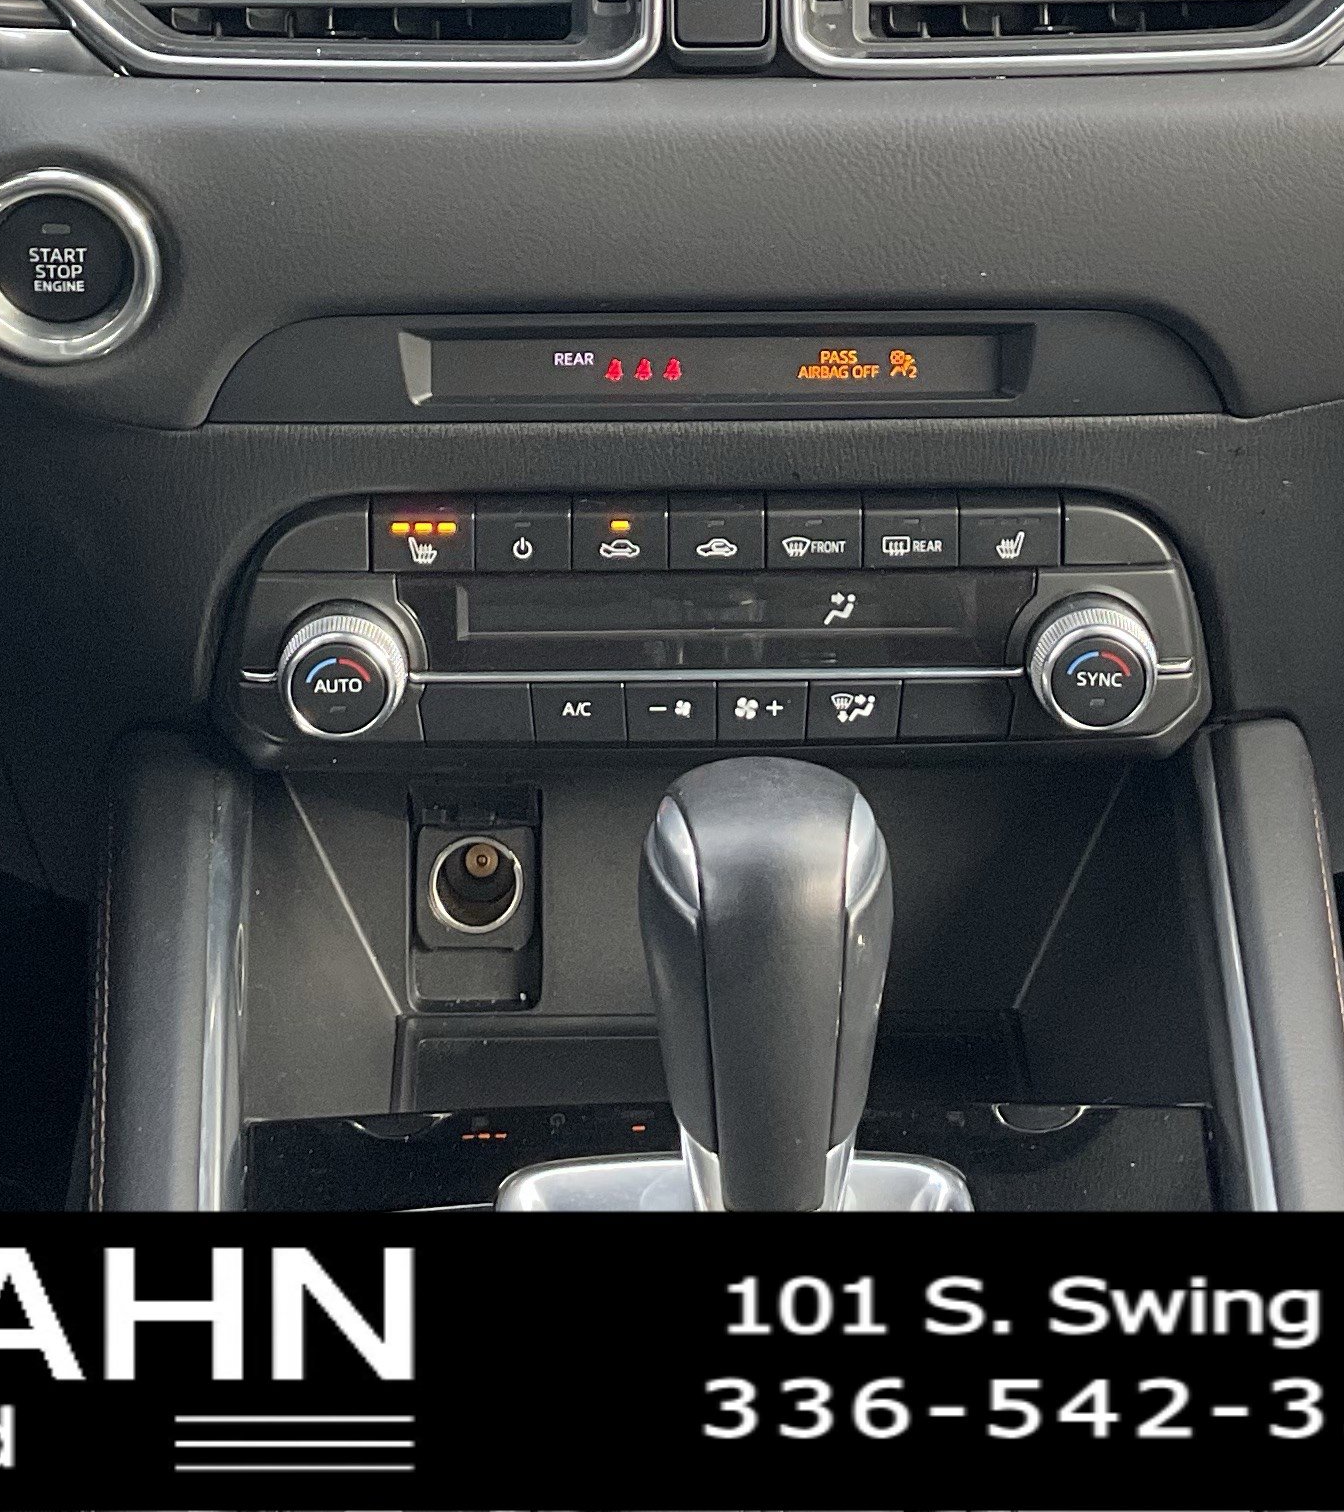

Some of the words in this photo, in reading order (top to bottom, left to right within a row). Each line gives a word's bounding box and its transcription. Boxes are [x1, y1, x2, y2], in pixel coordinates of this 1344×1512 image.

[29, 247, 88, 263] START
[35, 264, 83, 279] STOP
[33, 280, 85, 293] ENGINE
[554, 352, 594, 366] REAR
[820, 350, 858, 365] PASS
[797, 364, 849, 380] AIRBAG
[852, 364, 880, 379] OFF
[810, 539, 846, 555] FRONT
[912, 539, 943, 553] REAR
[313, 678, 363, 694] AUTO
[1075, 671, 1123, 688] SYNC
[562, 701, 592, 717] A/C
